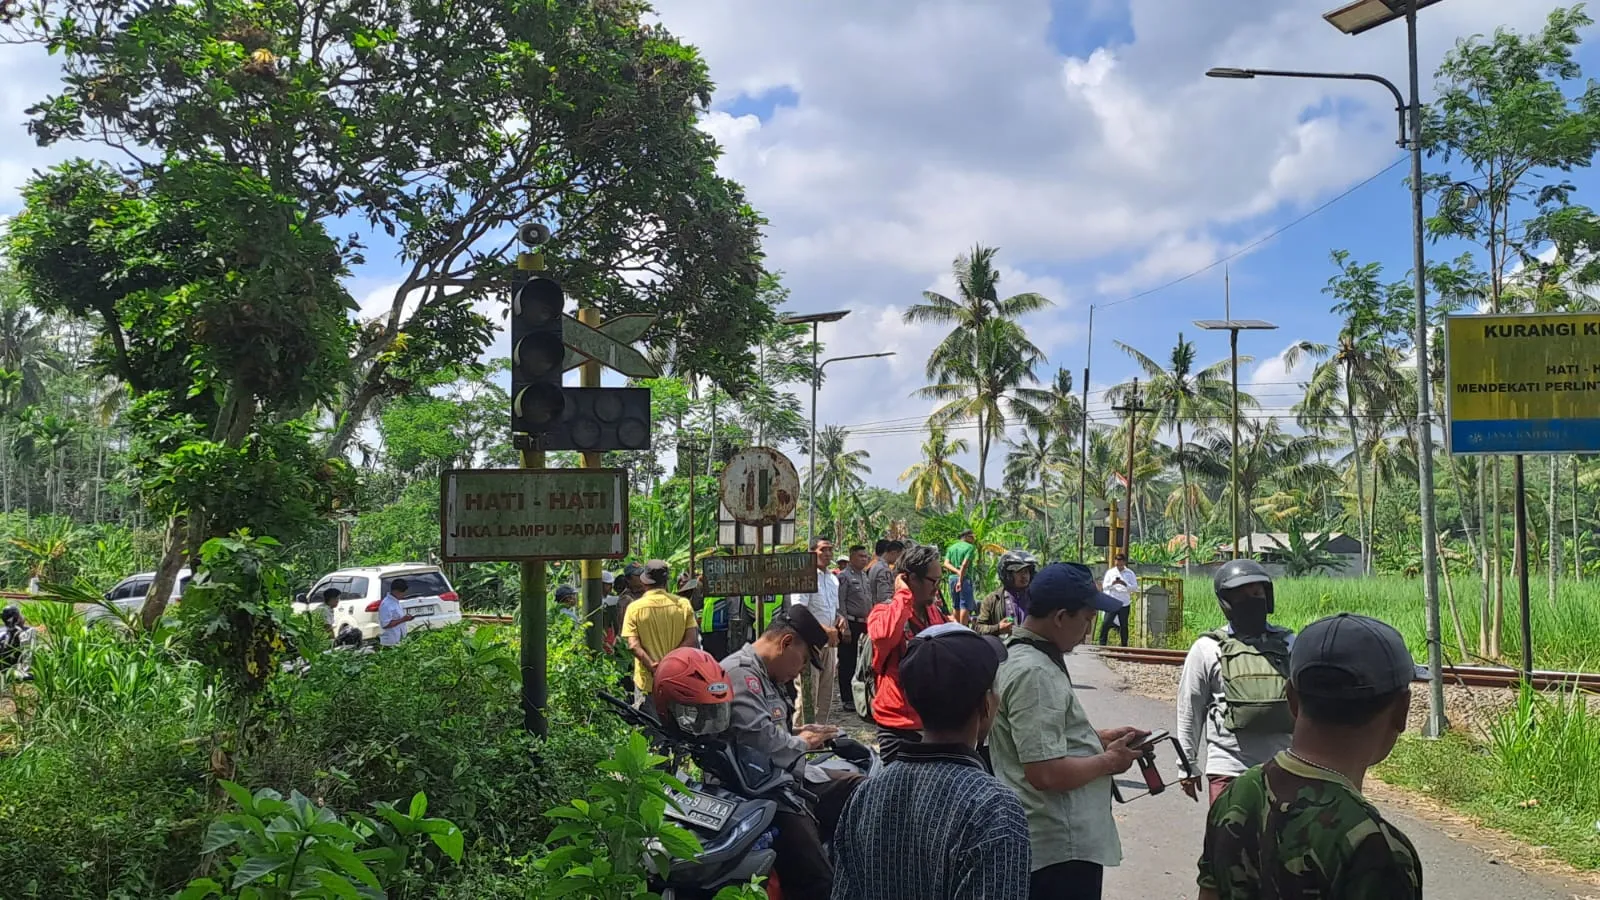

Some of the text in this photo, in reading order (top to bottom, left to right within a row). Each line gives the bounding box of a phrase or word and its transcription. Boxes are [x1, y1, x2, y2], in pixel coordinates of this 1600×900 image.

[1484, 323, 1576, 338] KURANGI
[1546, 365, 1579, 375] HATI
[1457, 382, 1540, 393] MENDEKATI
[465, 492, 525, 511] HATI
[548, 491, 607, 510] HATI
[450, 522, 621, 539] JIKA LAMPU PADAM
[706, 801, 729, 817] YAA
